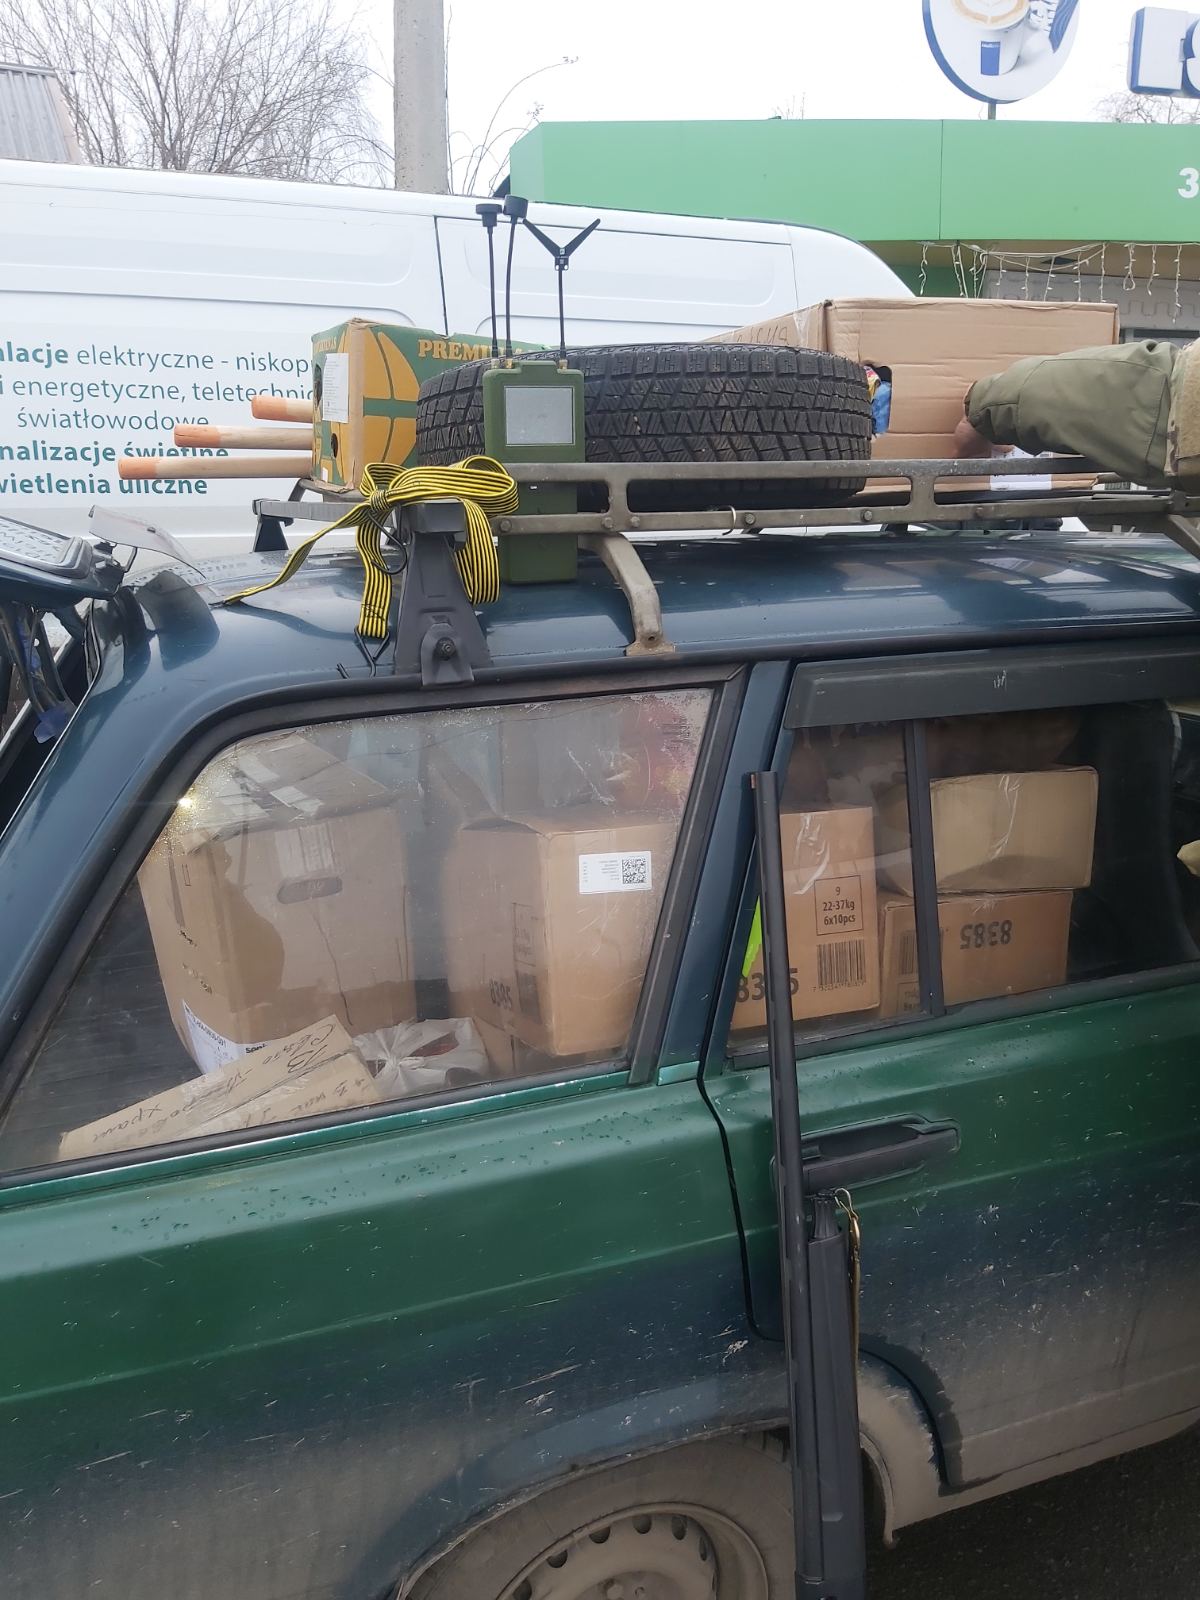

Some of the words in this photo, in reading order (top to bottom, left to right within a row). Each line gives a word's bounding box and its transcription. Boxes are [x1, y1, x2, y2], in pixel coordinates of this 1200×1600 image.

[77, 344, 214, 373] elektryczne
[236, 352, 313, 377] niskop
[12, 379, 186, 404] energetyczne,
[834, 886, 842, 896] 9
[823, 899, 856, 912] 22-37kg
[823, 913, 856, 926] 6x10pcs
[736, 967, 799, 1003] 835
